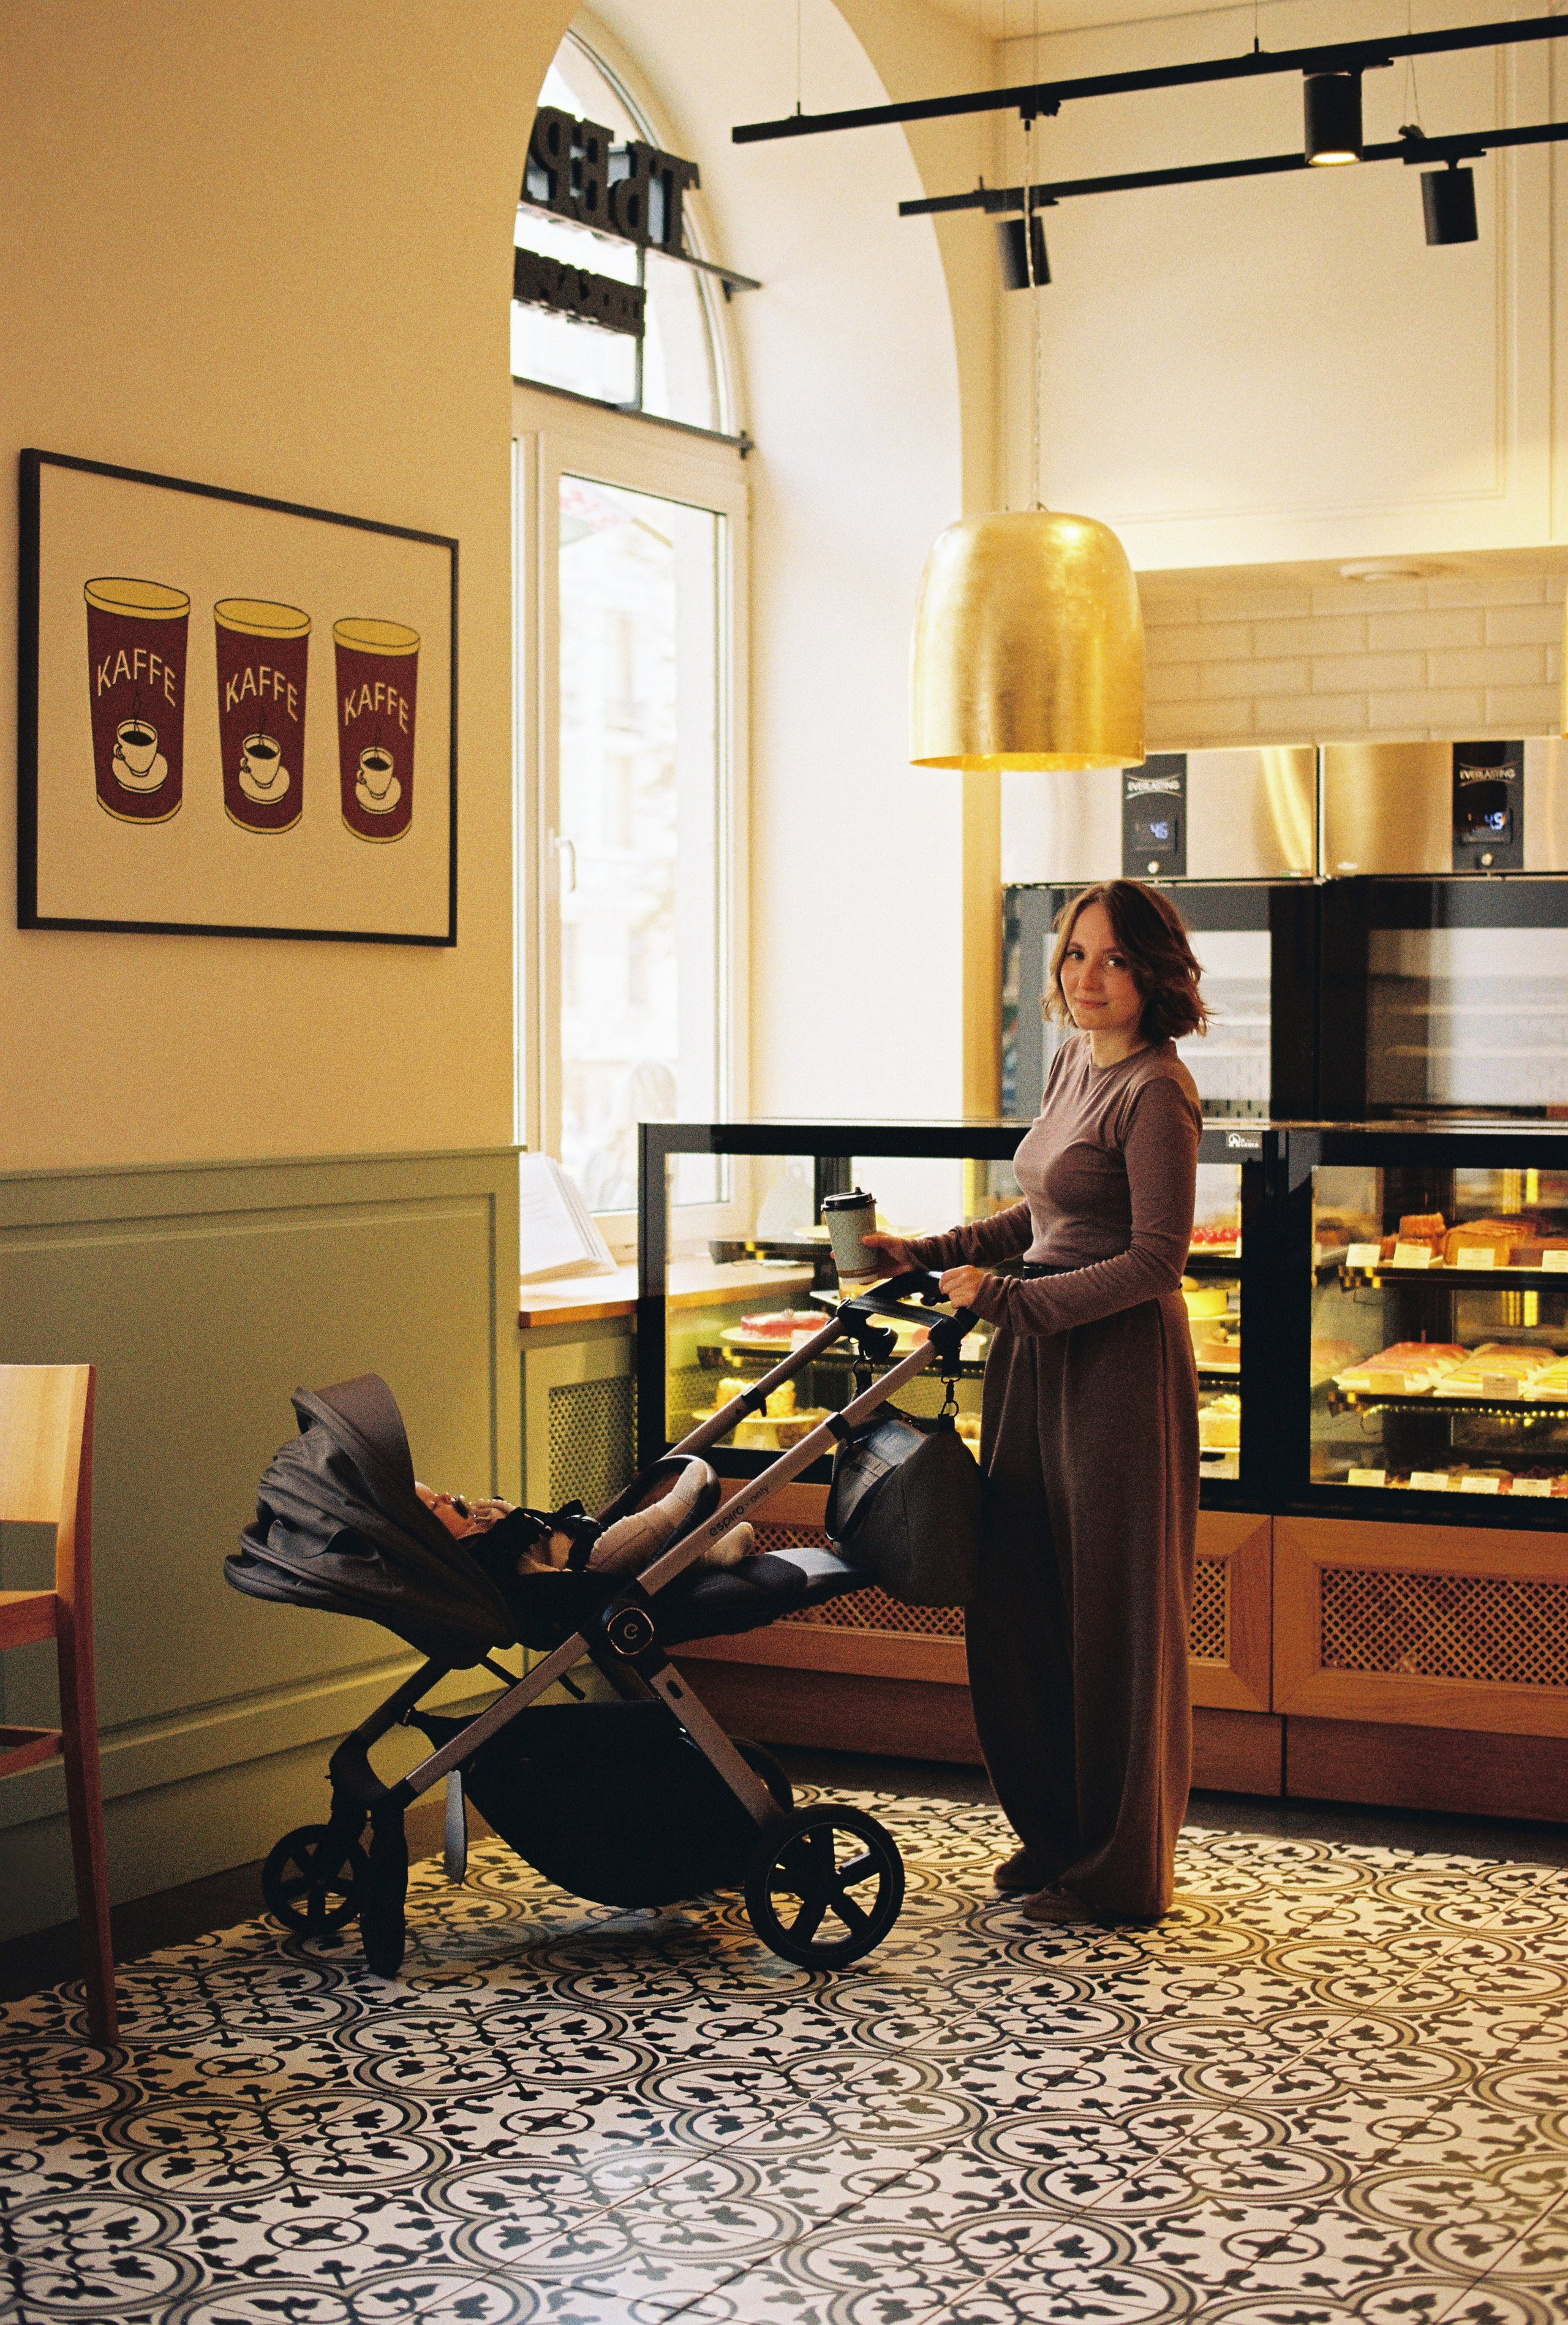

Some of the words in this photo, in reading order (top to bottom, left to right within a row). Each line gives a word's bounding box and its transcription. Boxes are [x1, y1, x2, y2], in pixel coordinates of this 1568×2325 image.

[97, 648, 177, 708] KAFFE
[225, 665, 300, 722] KAFFE
[344, 681, 409, 735] KAFFE
[710, 1506, 745, 1537] espiro
[751, 1485, 769, 1503] only
